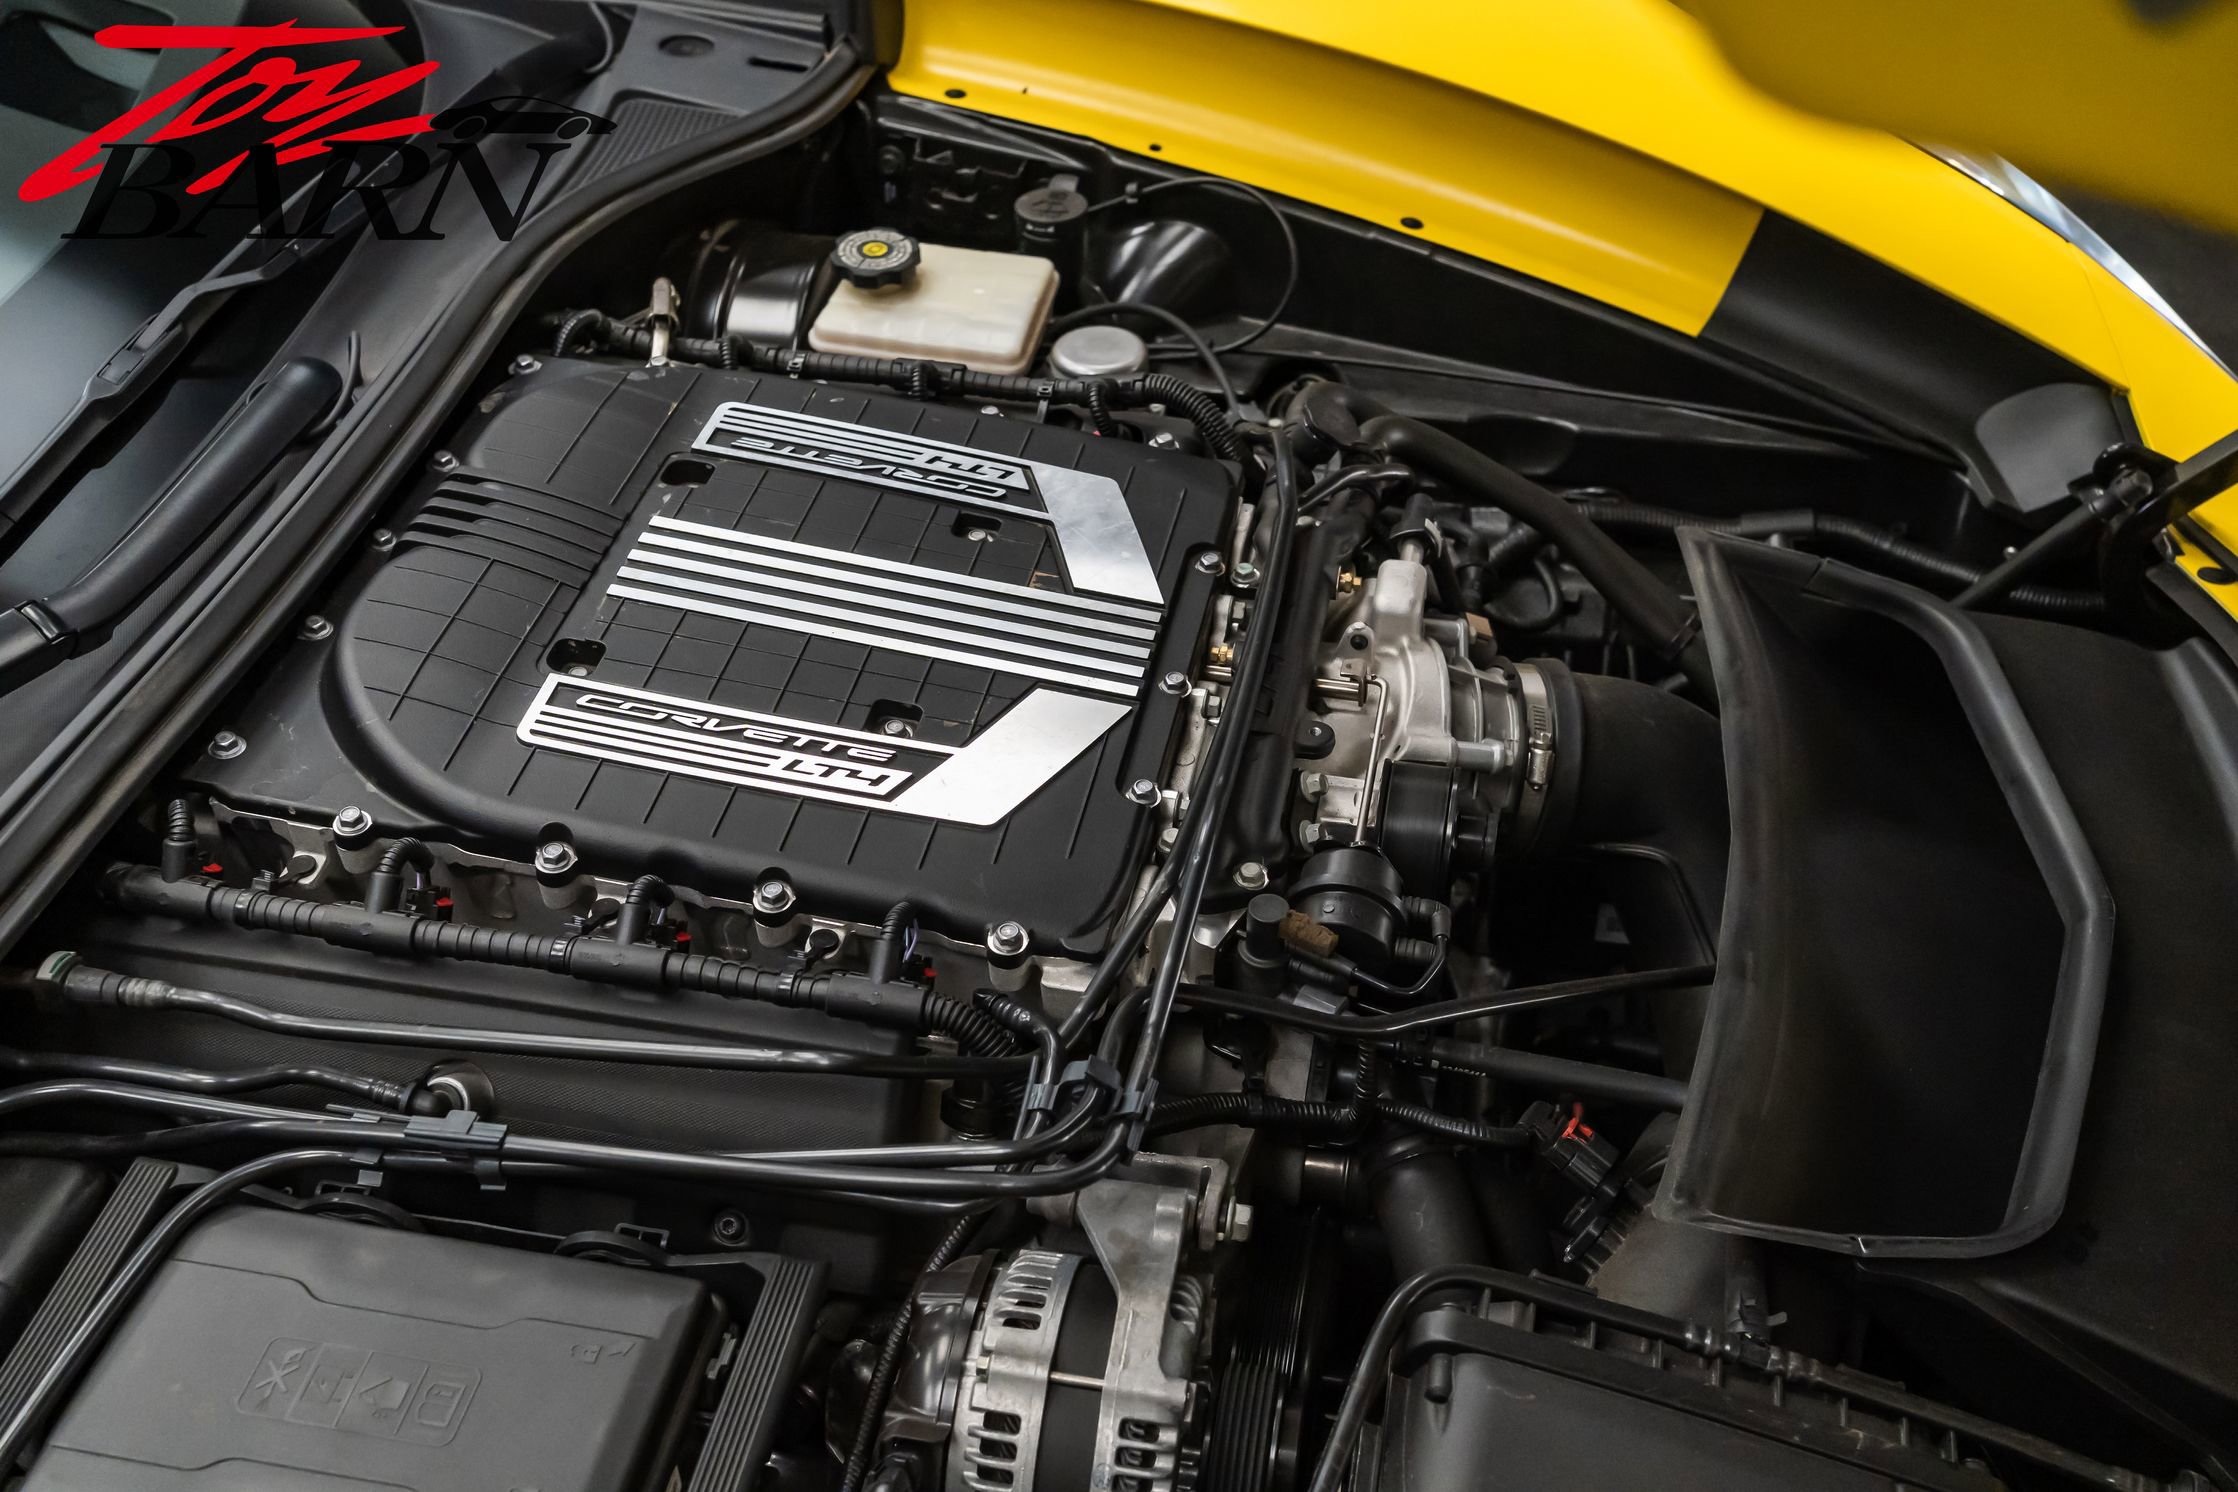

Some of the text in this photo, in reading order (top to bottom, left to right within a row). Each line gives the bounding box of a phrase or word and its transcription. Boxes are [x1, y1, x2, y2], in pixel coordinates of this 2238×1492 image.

[731, 436, 1007, 498] CORVETTE
[925, 455, 1016, 481] LT4
[575, 693, 897, 762] CORVETTE
[781, 758, 891, 787] LT4
